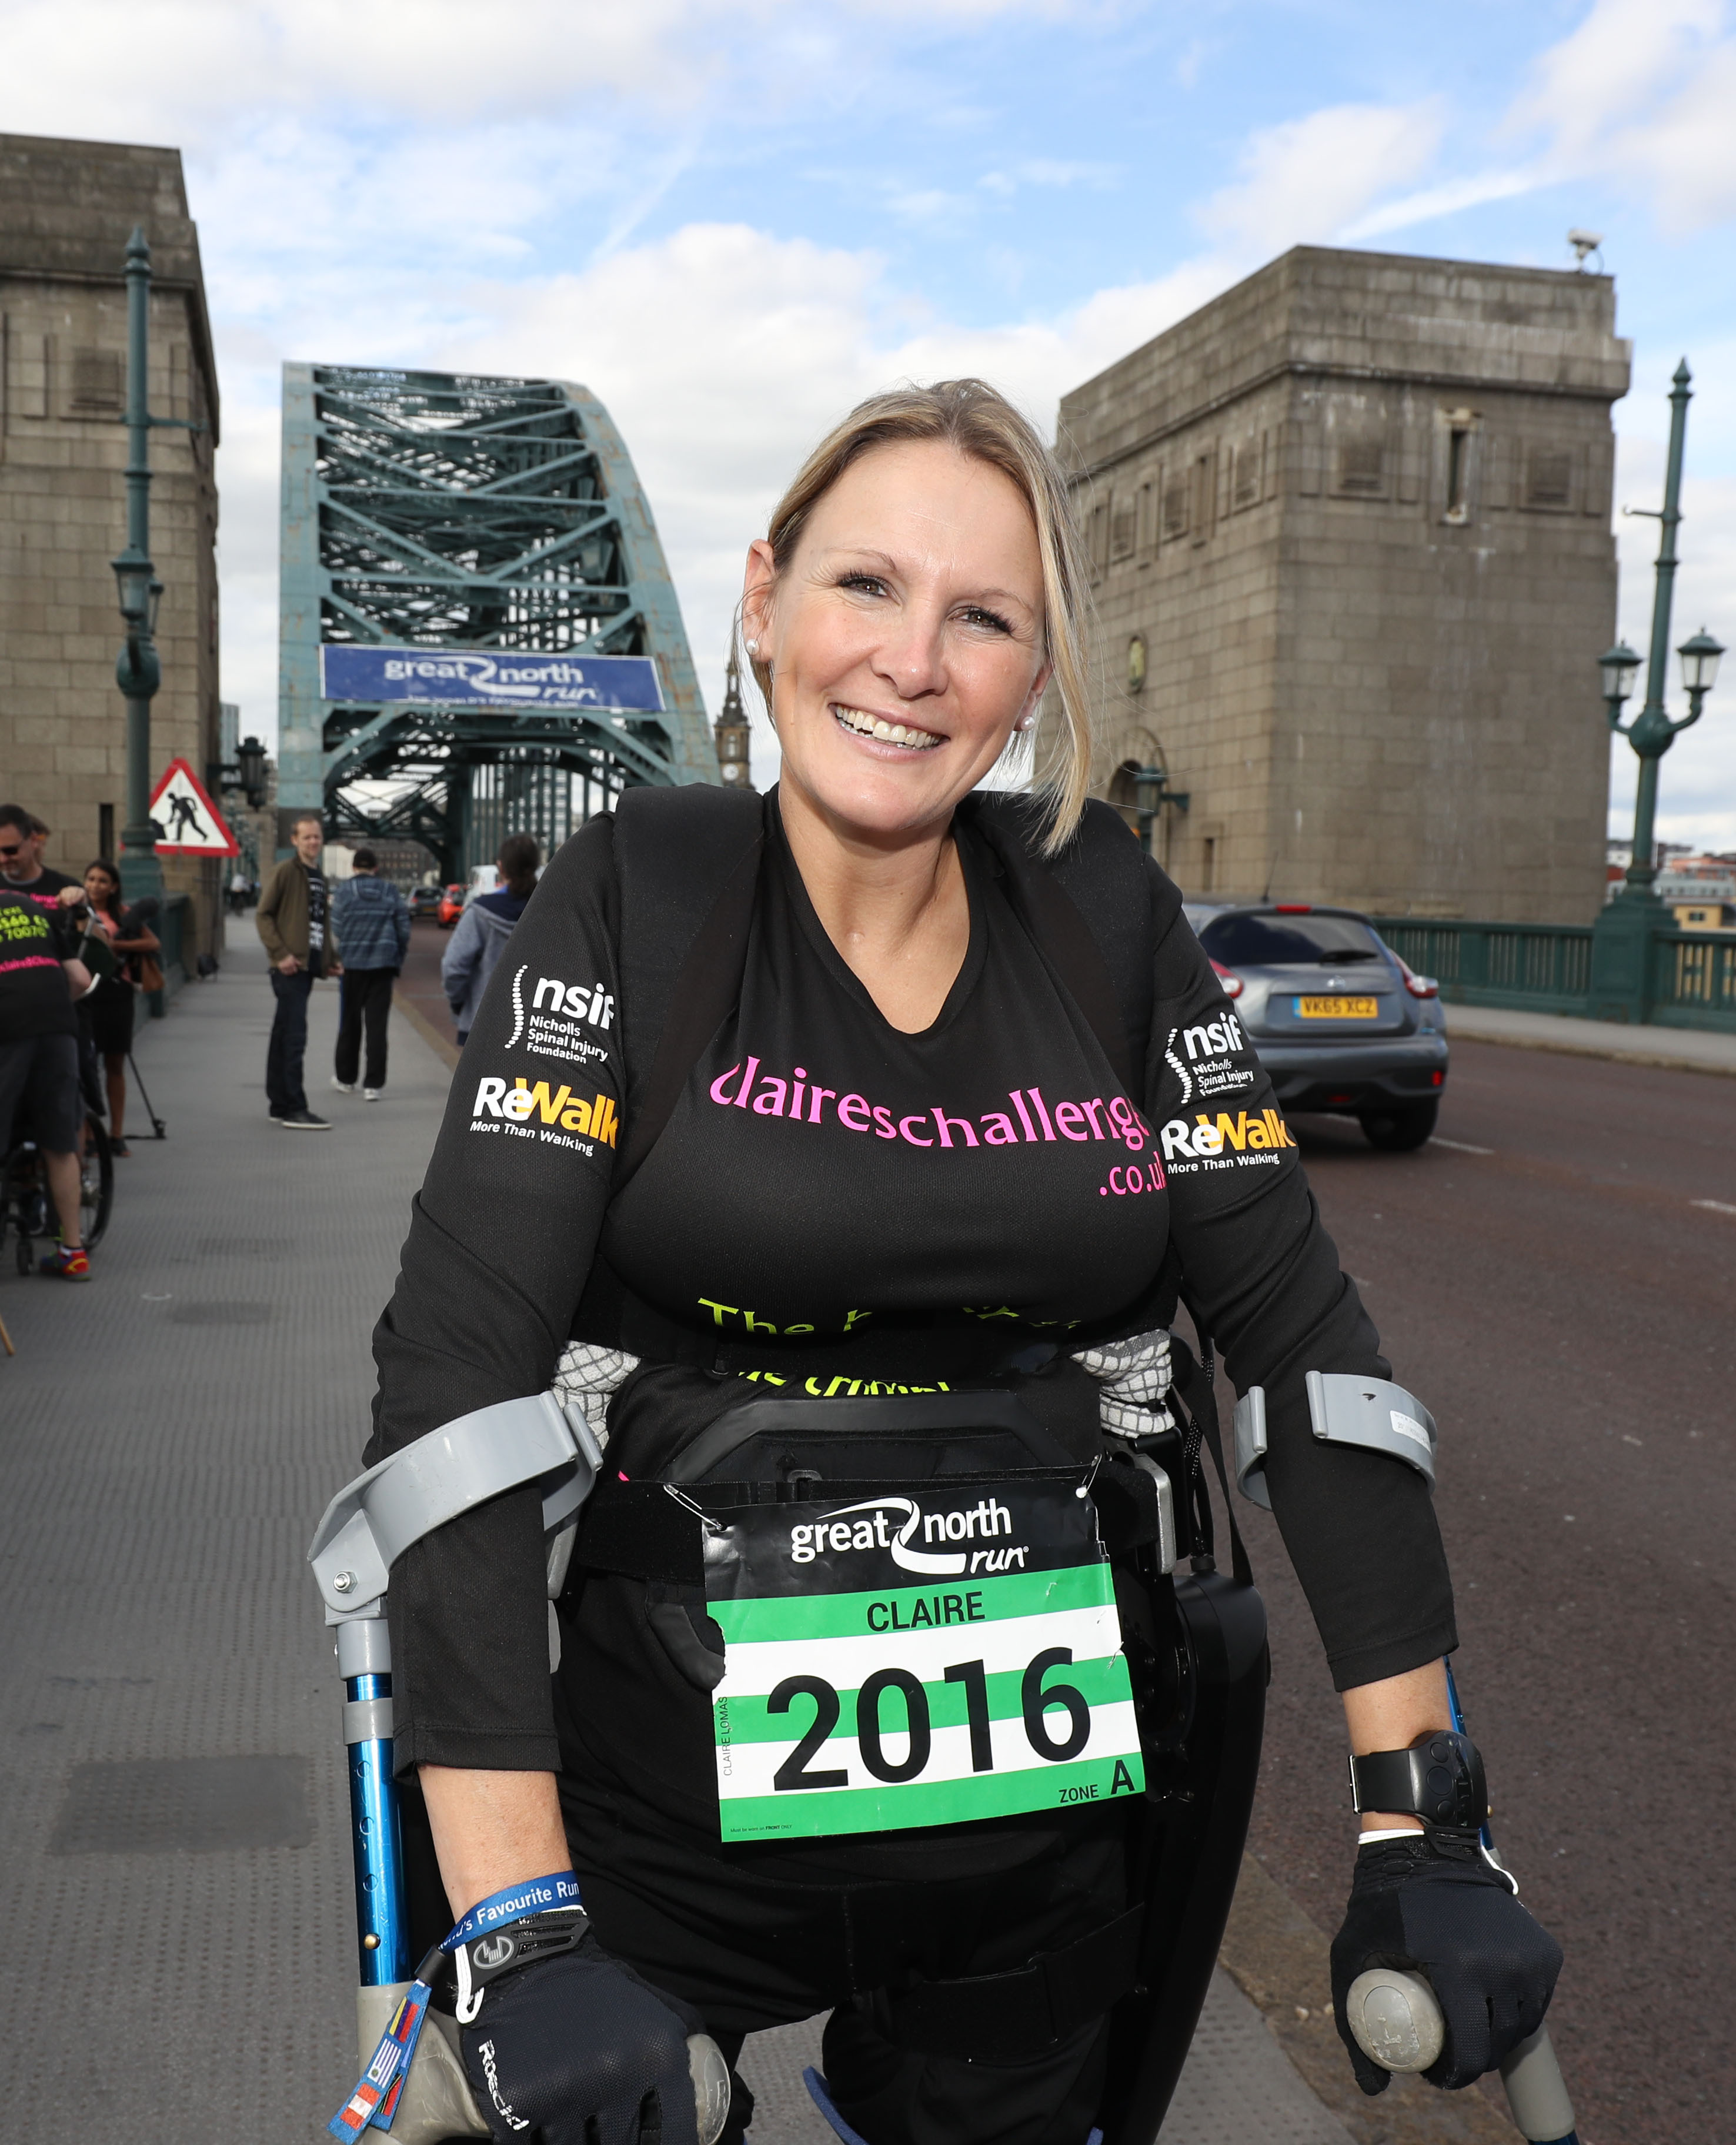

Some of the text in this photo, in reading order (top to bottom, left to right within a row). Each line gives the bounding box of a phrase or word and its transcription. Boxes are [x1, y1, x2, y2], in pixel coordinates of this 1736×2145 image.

[384, 659, 584, 684] great north
[543, 686, 597, 700] run
[1304, 997, 1375, 1013] VK65 XCZ
[530, 1015, 581, 1037] Nicholls
[1183, 1011, 1244, 1060] nsif
[527, 1041, 587, 1064] Foundation
[528, 1028, 608, 1063] Spinal Injury
[1192, 1058, 1232, 1075] Nicholls
[1198, 1070, 1254, 1089] Spinal Injury
[472, 1077, 619, 1150] ReWalk
[469, 1121, 594, 1157] More Than Walking
[1160, 1109, 1297, 1160] ReWalk
[1167, 1152, 1280, 1175] More Than Walking
[790, 1498, 1011, 1563] great north
[867, 1591, 985, 1632] CLAIRE
[718, 1696, 732, 1776] CLAIRE LOMAS
[766, 1646, 1091, 1791] 2016
[1059, 1759, 1136, 1803] ZONE A
[476, 1888, 552, 1925] Favourite
[556, 1881, 580, 1899] Run
